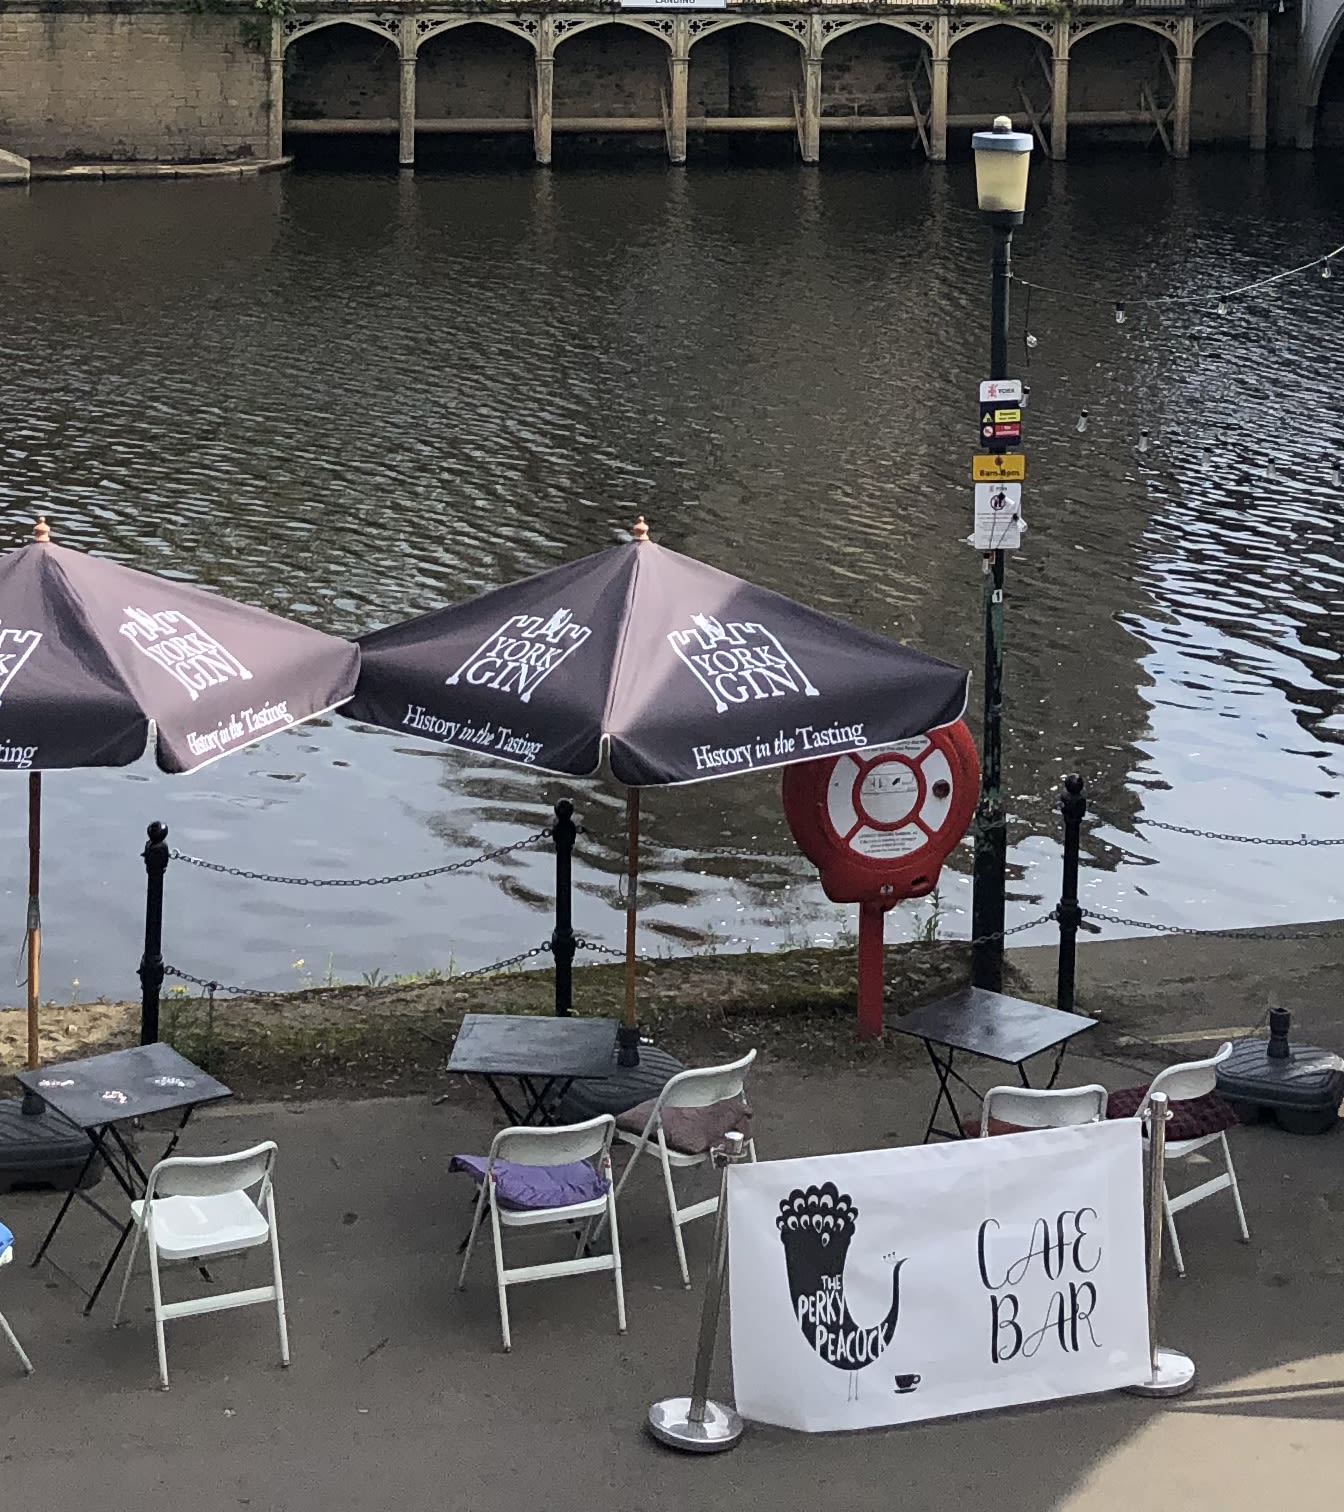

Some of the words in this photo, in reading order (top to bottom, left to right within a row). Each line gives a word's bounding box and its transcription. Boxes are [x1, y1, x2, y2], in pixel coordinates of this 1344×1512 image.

[147, 632, 218, 666] YORK
[486, 637, 563, 669] YORK
[691, 645, 787, 676] YORK
[175, 649, 238, 690] GIN
[466, 657, 545, 694] GIN
[715, 663, 800, 703] GIN
[186, 727, 225, 756] History
[218, 721, 230, 745] in
[228, 714, 244, 740] the
[241, 700, 294, 733] Tasting
[402, 704, 460, 742] History
[459, 719, 476, 742] in
[475, 722, 495, 746] the
[495, 726, 544, 762] Tasting
[692, 744, 752, 770] History
[756, 736, 771, 759] in
[774, 730, 795, 754] the
[796, 721, 867, 750] Tasting
[977, 1207, 1102, 1290] CAFE
[820, 1274, 842, 1290] THE
[798, 1290, 845, 1329] PERKY
[990, 1281, 1102, 1363] BAR
[815, 1322, 889, 1363] PEACOCK
